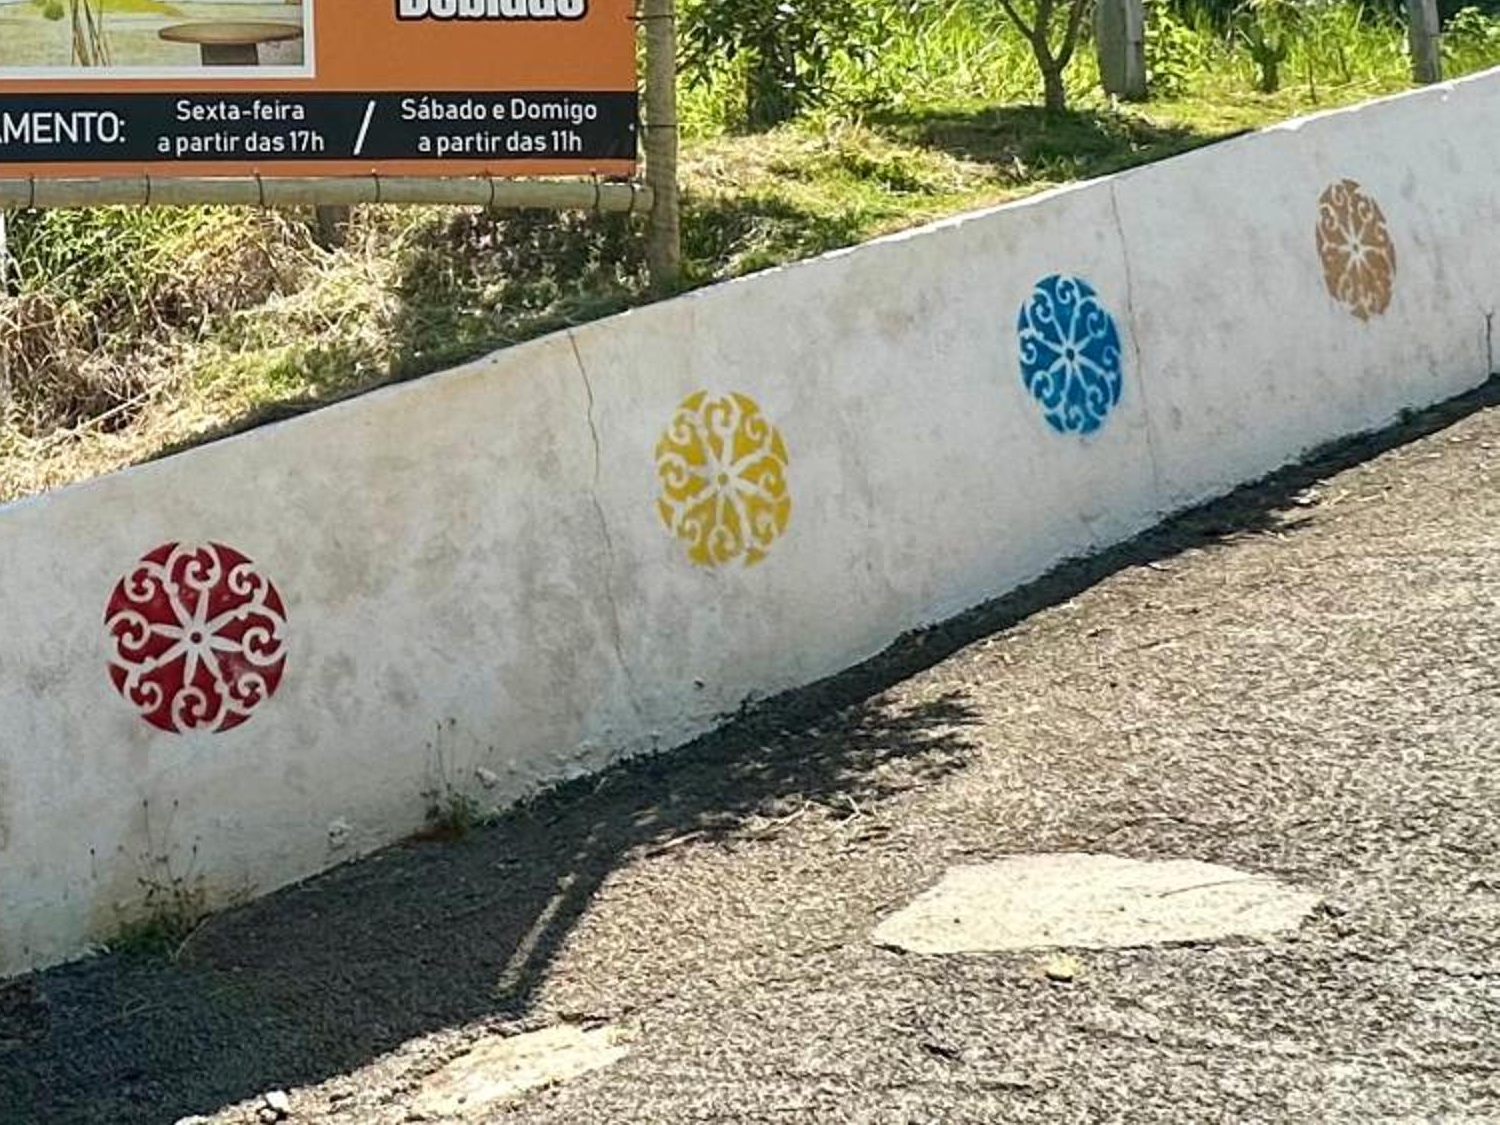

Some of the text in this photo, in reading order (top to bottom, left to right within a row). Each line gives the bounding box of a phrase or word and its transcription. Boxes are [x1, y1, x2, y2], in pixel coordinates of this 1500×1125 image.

[176, 99, 305, 121] Sexta-feira
[401, 96, 598, 125] Sábado e Domigo
[157, 130, 325, 157] a partir das 17h
[417, 130, 583, 158] a partir das 11h
